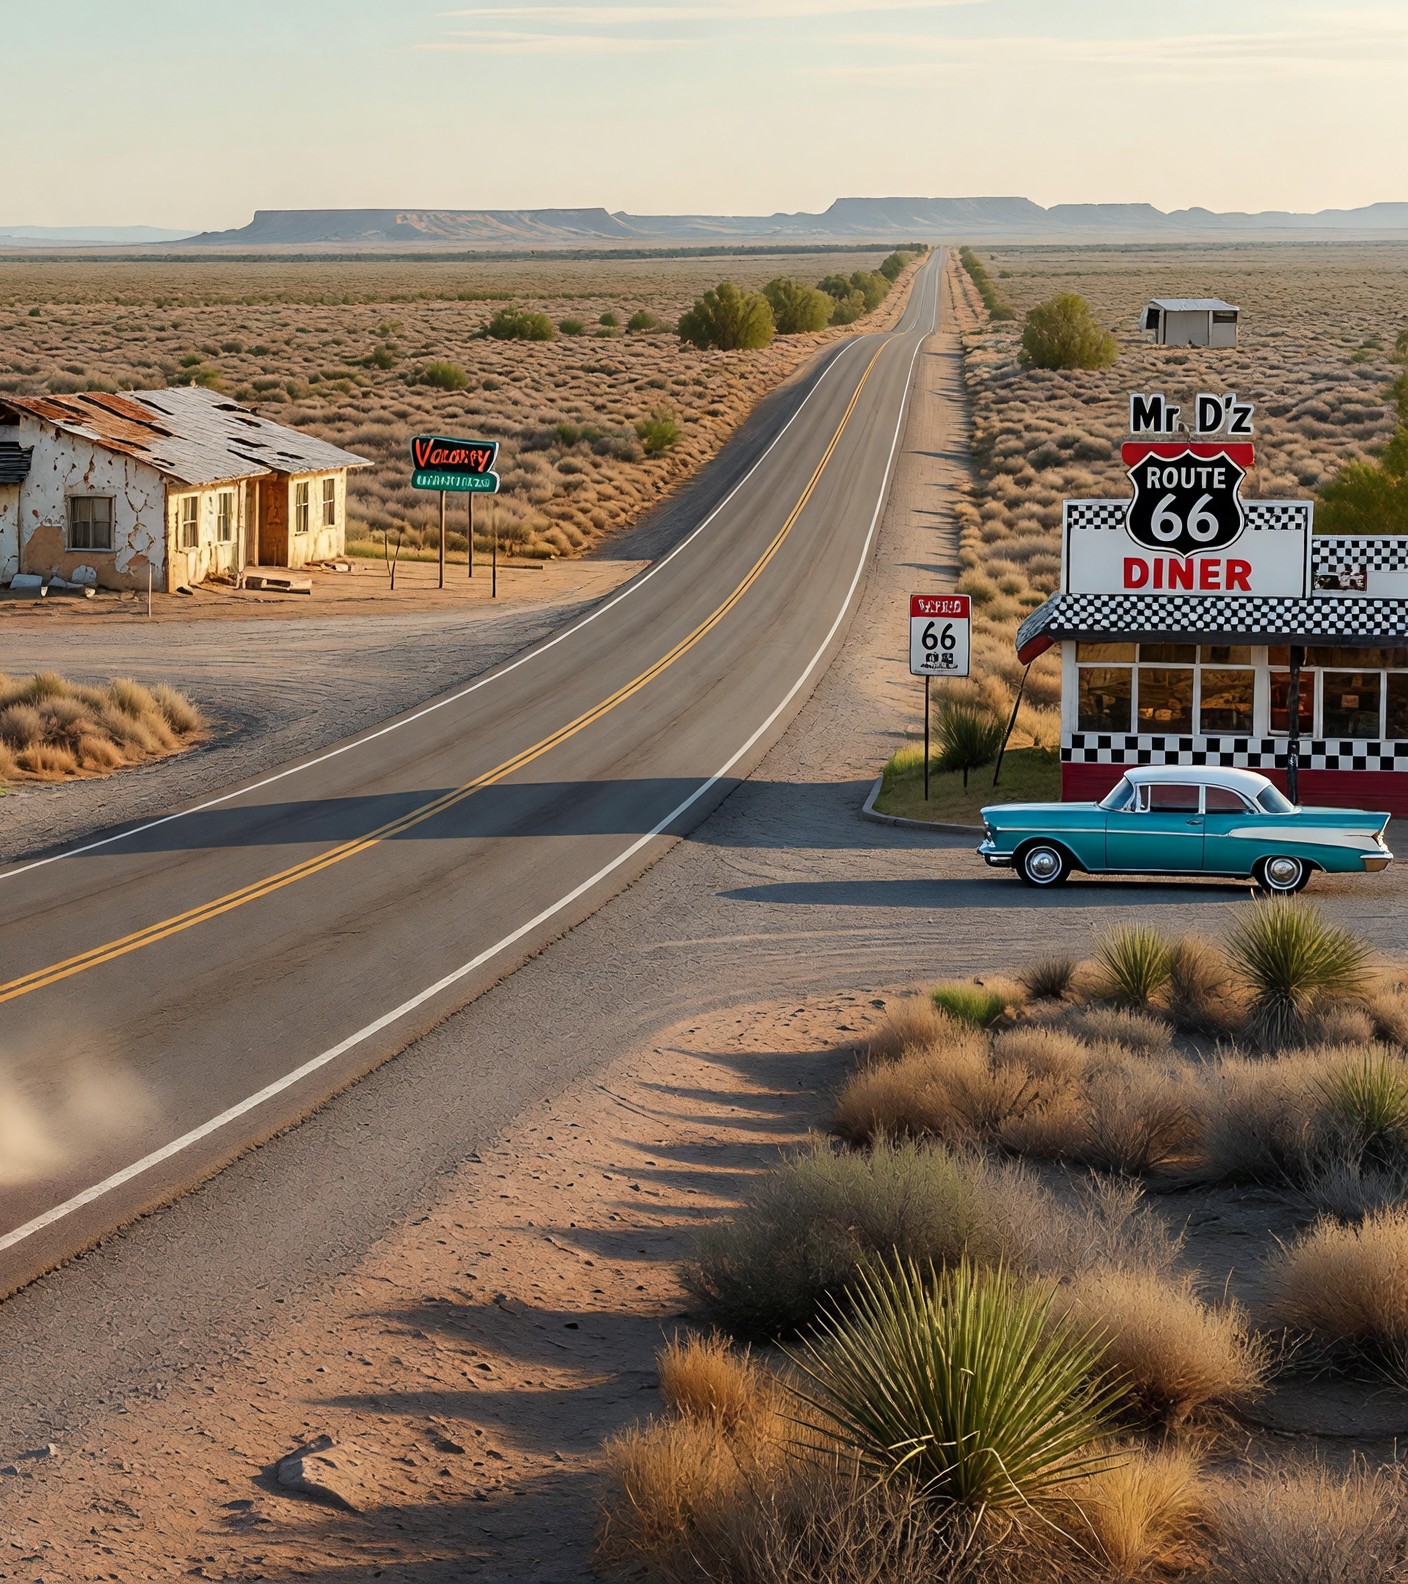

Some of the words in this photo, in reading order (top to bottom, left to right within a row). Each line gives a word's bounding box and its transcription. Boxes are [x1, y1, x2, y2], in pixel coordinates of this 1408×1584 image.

[1196, 393, 1254, 435] D'z
[1146, 466, 1227, 489] ROUTE
[1150, 493, 1219, 542] 66
[1123, 557, 1253, 592] DINER
[921, 620, 956, 651] 66
